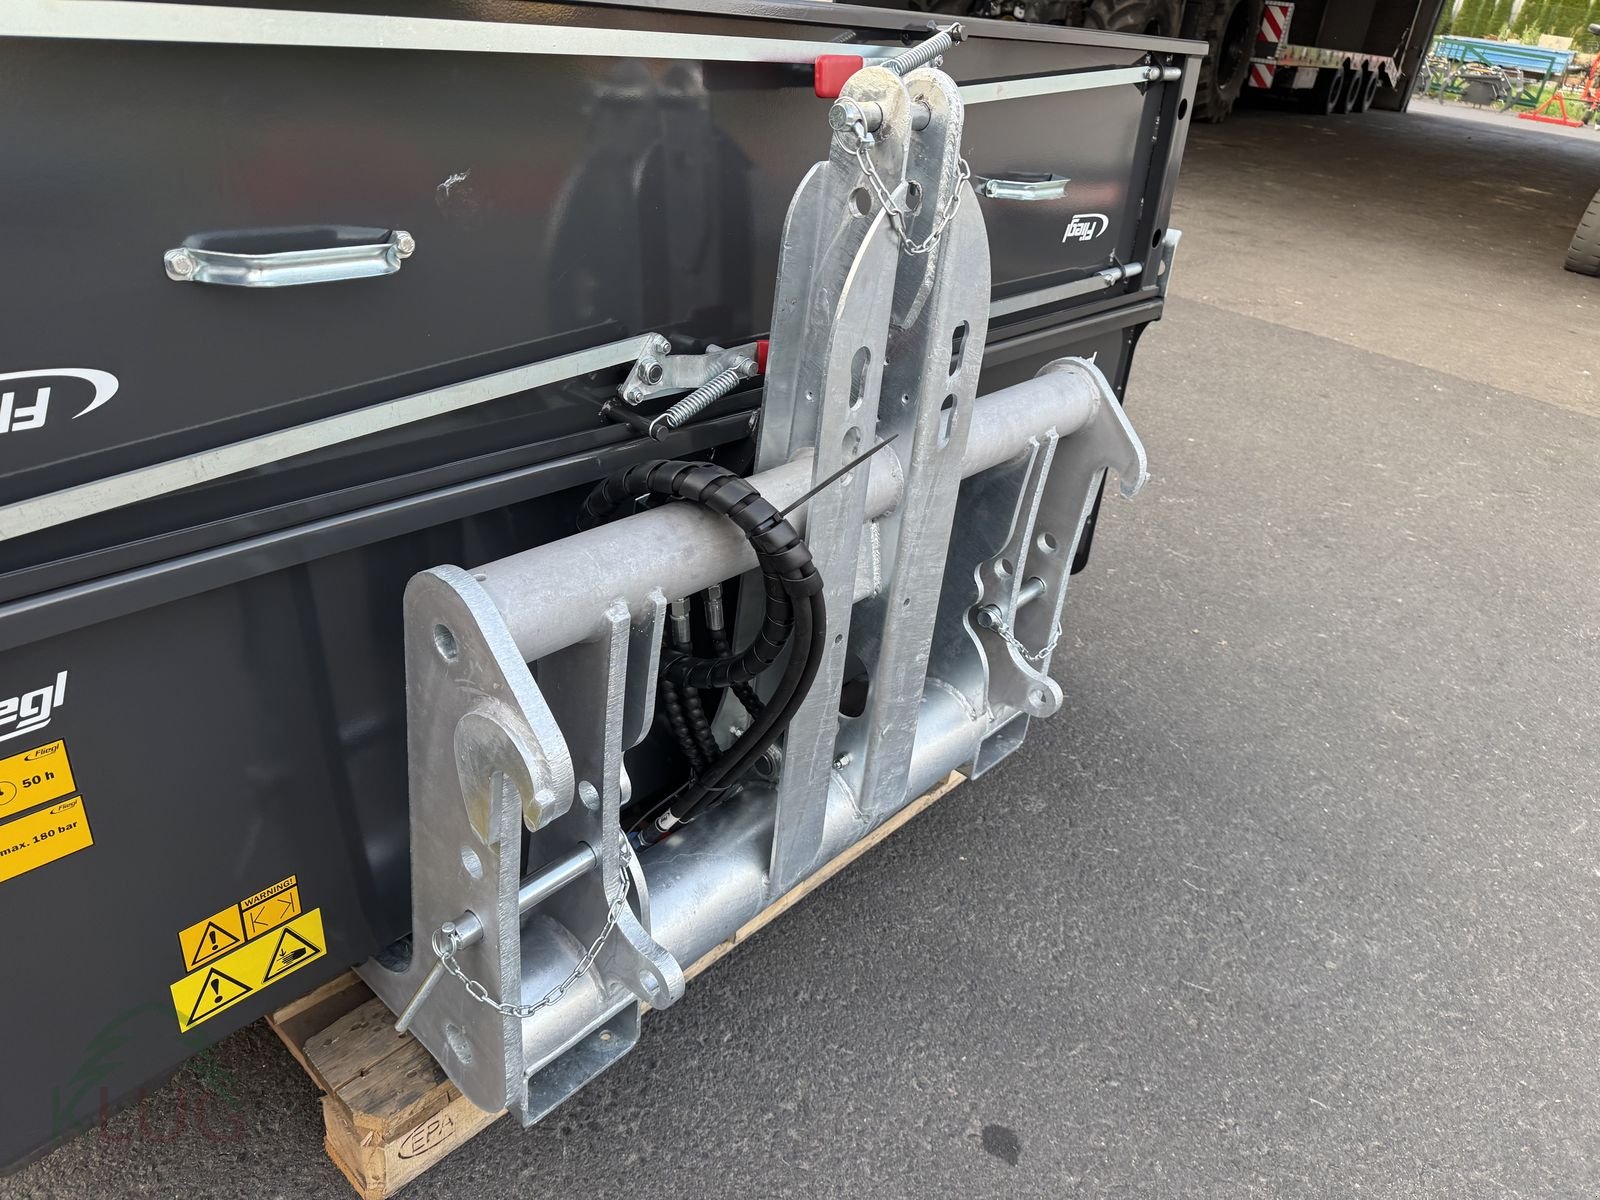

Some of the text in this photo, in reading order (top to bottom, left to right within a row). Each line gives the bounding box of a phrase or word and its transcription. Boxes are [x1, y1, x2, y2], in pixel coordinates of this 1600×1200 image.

[22, 771, 55, 788] 50 h
[0, 821, 78, 857] max. 180 bar
[244, 878, 293, 907] WARNING!
